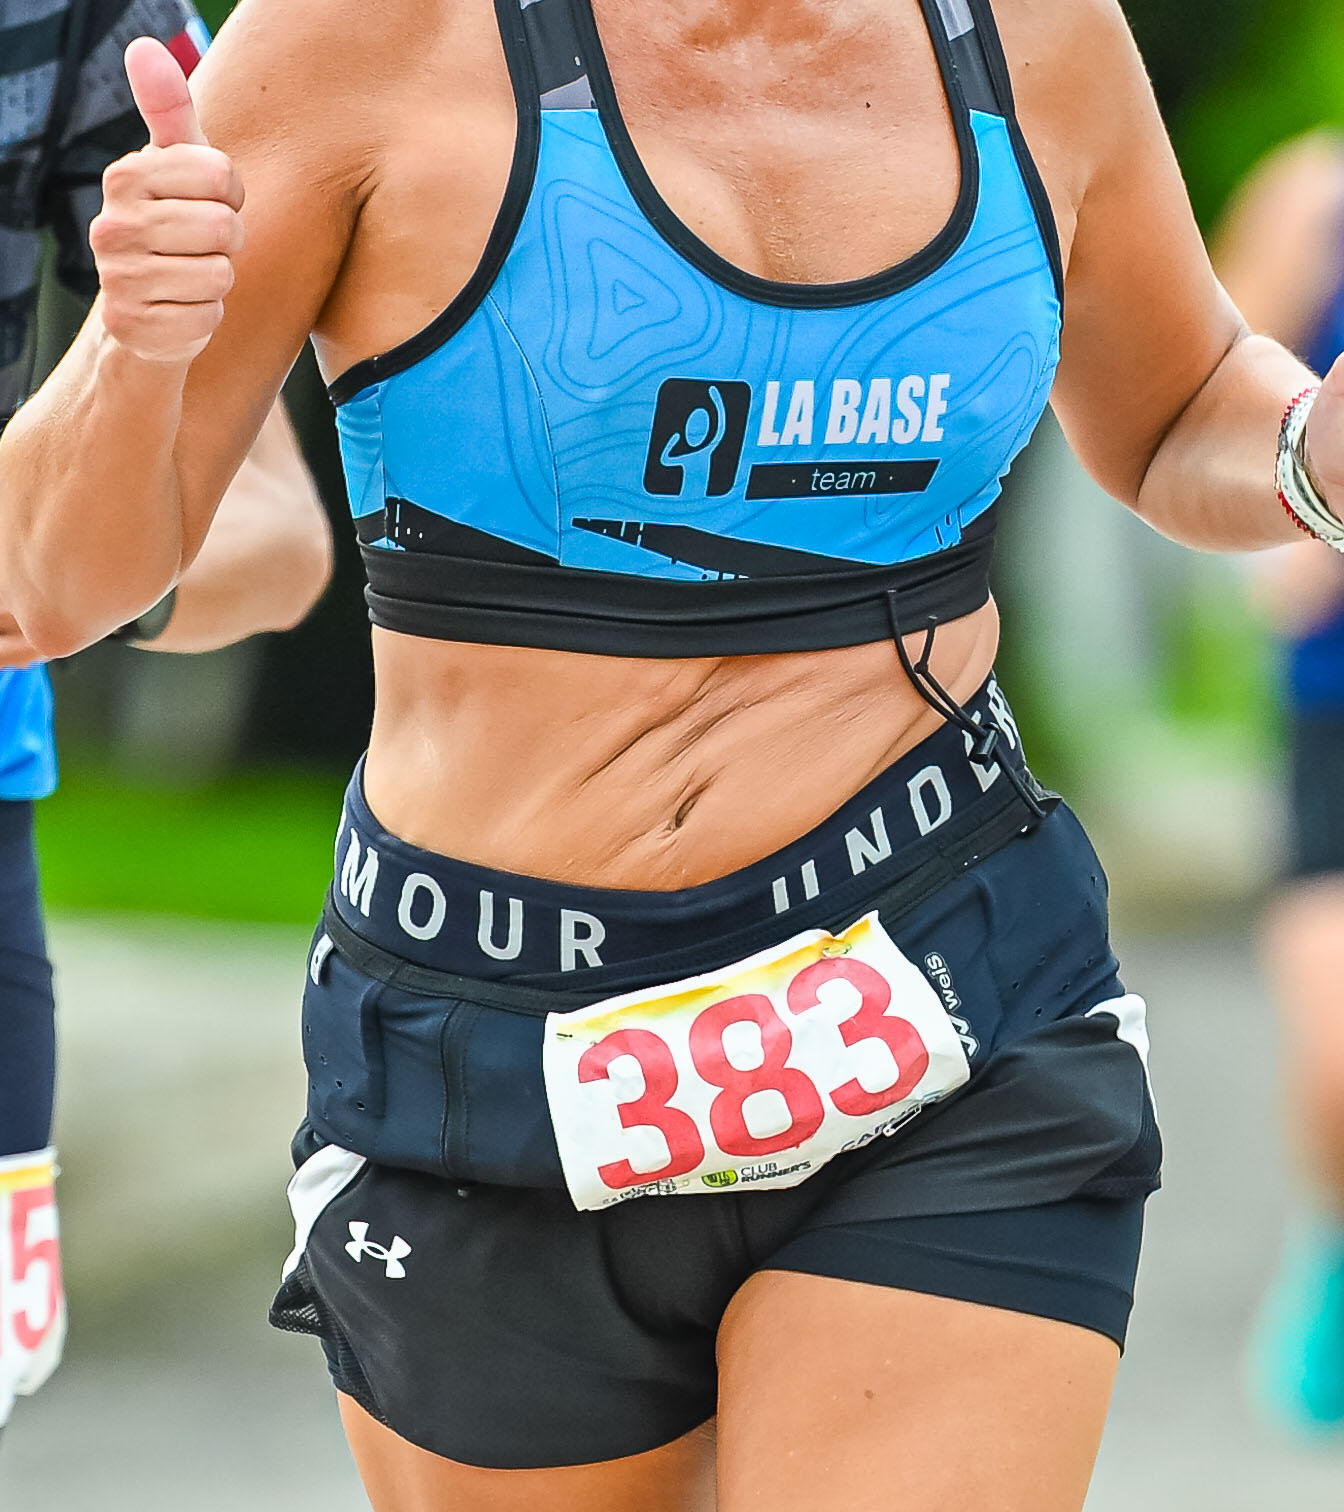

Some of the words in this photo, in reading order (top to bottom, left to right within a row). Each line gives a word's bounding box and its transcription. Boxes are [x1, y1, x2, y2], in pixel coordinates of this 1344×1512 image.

[757, 379, 815, 446] LA
[824, 374, 951, 445] BASE
[811, 468, 877, 492] team
[335, 810, 607, 973] MOUR
[926, 954, 959, 1010] weis
[578, 956, 930, 1190] 383
[740, 1162, 777, 1178] CLUB
[741, 1160, 811, 1183] RUNNER'S
